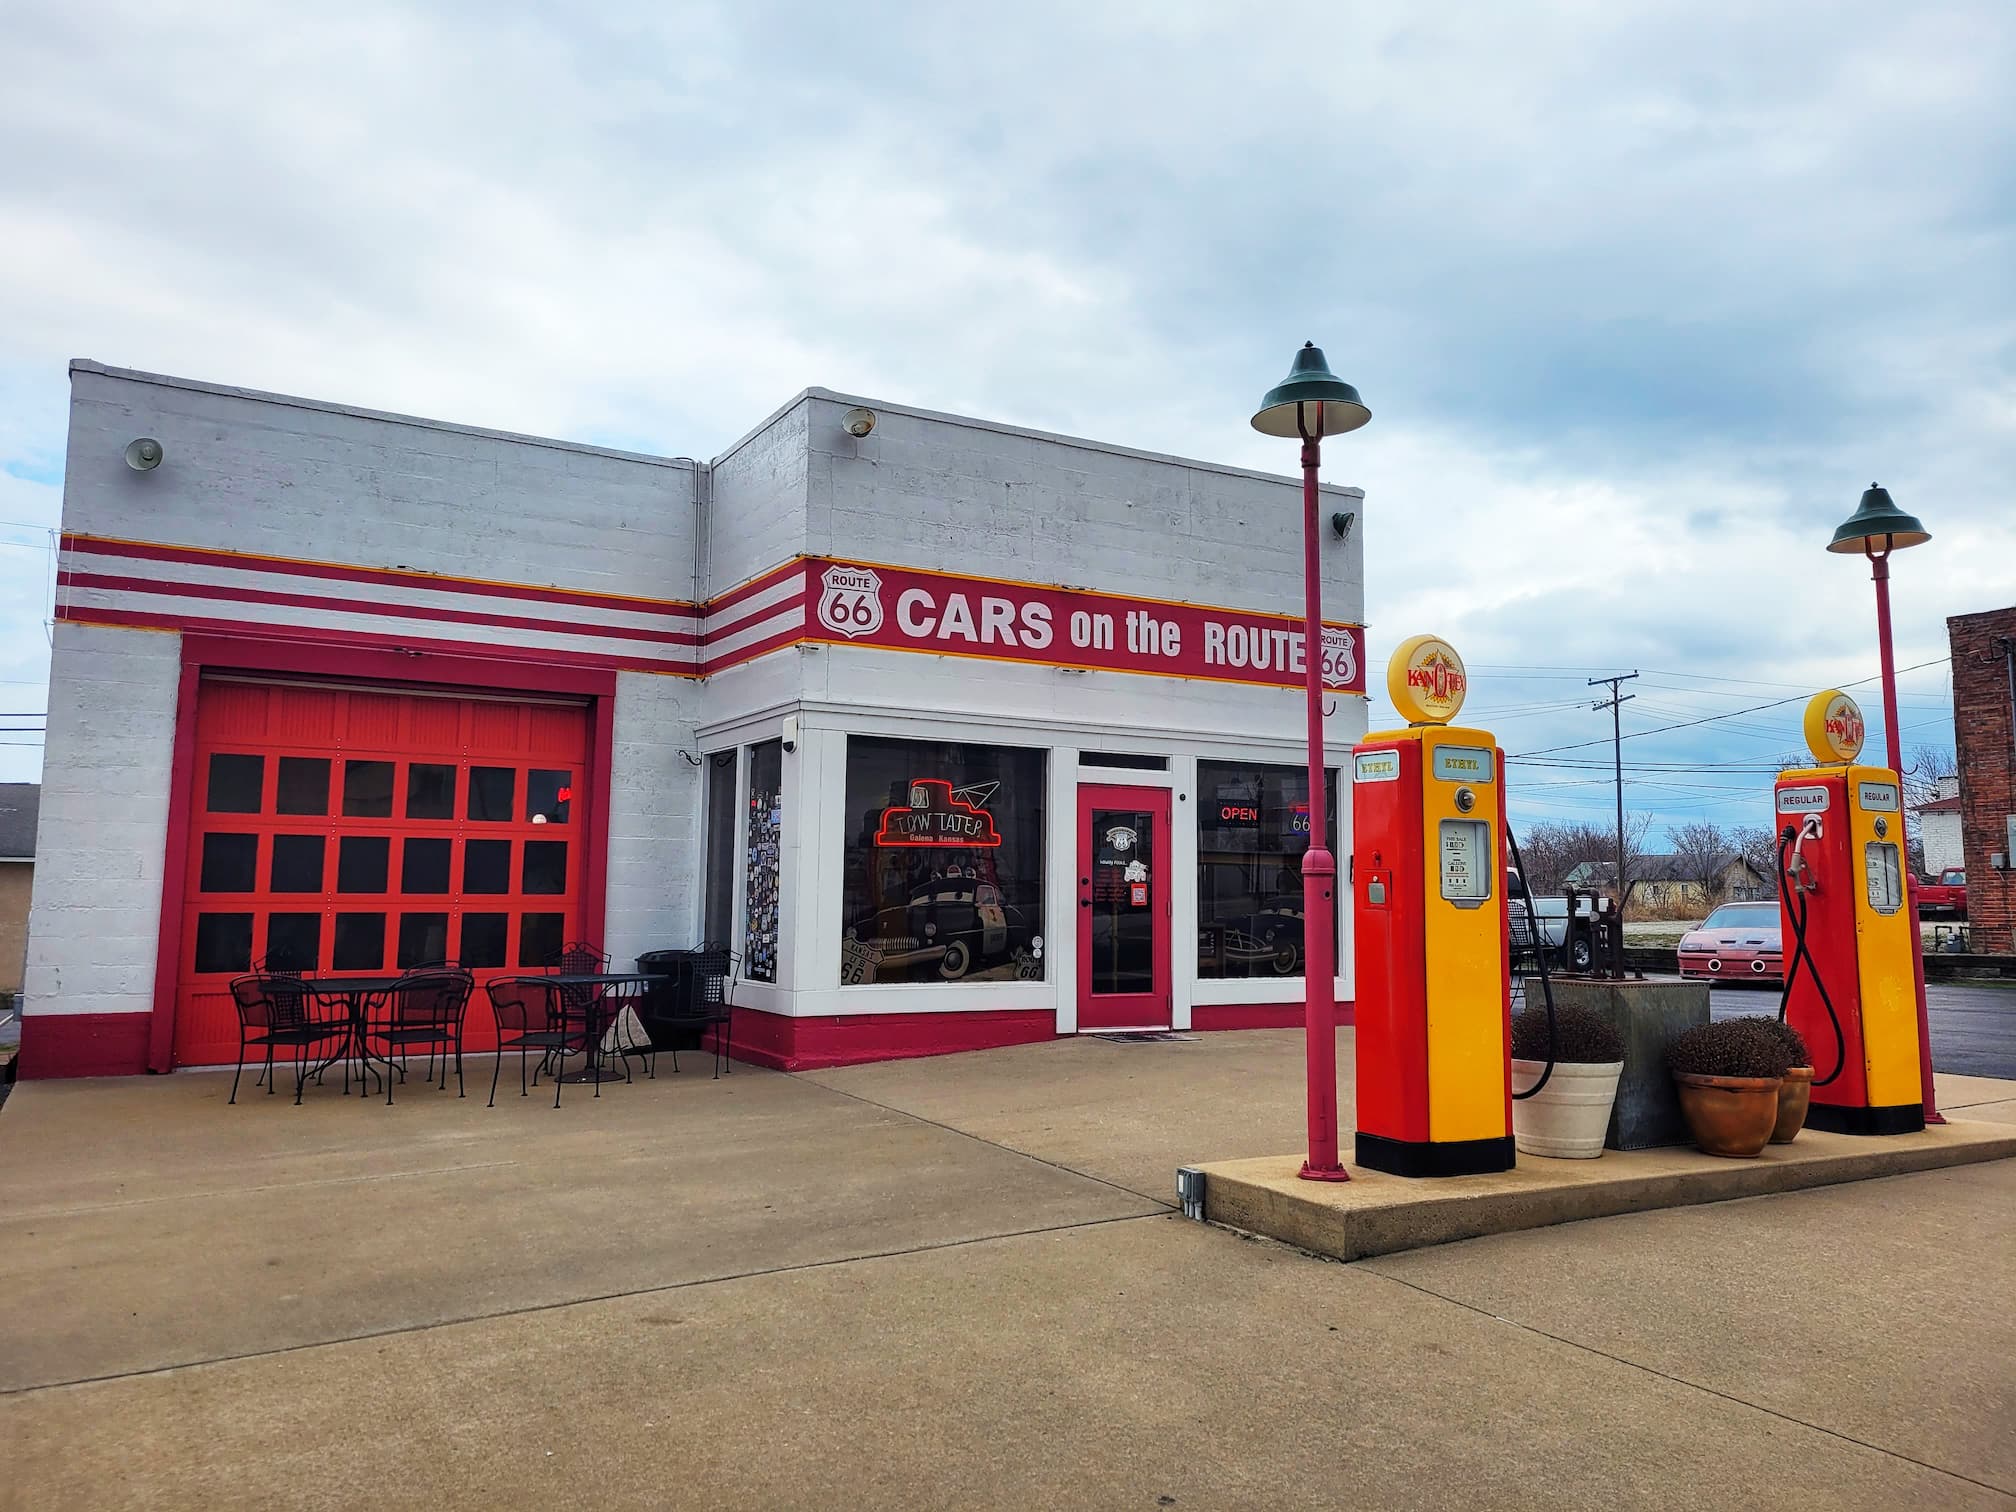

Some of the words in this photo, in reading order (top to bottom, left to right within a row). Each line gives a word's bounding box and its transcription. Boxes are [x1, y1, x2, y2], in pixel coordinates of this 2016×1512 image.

[832, 575, 870, 588] ROUTE
[830, 592, 872, 625] 66
[896, 588, 1053, 649] CARS
[1070, 610, 1114, 650] on
[1126, 610, 1181, 657] the
[1204, 621, 1307, 674] ROUTE
[1321, 635, 1348, 647] ROUTE
[1322, 648, 1348, 677] 66
[1361, 761, 1394, 774] ETHYL
[1444, 758, 1480, 770] ETHYL
[1783, 795, 1824, 805] REGULAR
[1864, 791, 1890, 801] REGULAR
[1221, 806, 1258, 821] OPEN
[1292, 815, 1311, 832] 66
[938, 834, 964, 843] Kansas
[851, 944, 874, 959] KANSAS
[842, 963, 863, 984] 66
[1021, 966, 1038, 978] 66
